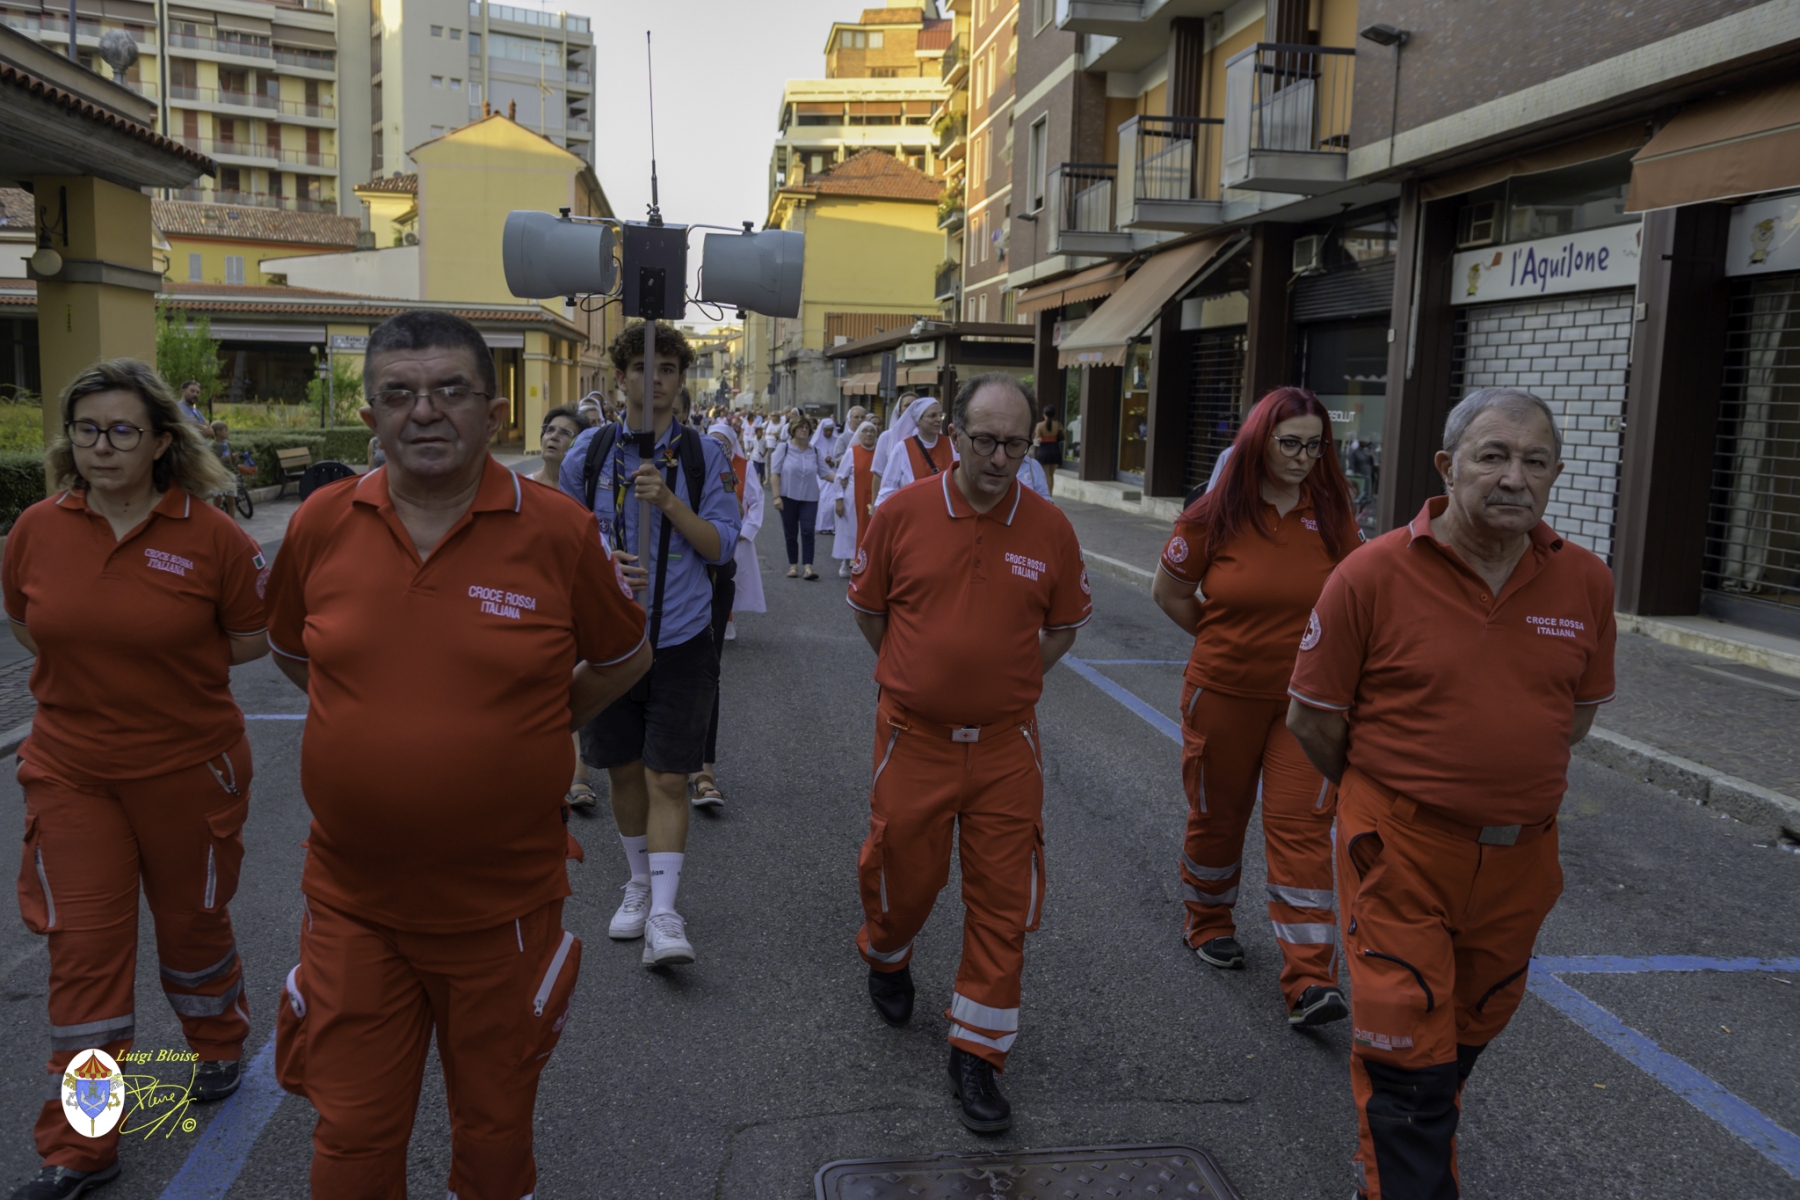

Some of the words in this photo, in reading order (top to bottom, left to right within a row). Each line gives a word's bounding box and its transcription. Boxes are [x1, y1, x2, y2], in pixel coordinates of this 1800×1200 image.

[1511, 242, 1610, 292] l'Aquilone
[1004, 552, 1027, 566] CROCE
[1027, 557, 1046, 574] ROSSA
[1011, 564, 1039, 582] ITALIANA
[468, 585, 504, 603] CROCE
[505, 592, 536, 611] ROSSA
[480, 600, 521, 619] ITALIANA
[1526, 615, 1557, 626] CROCE
[1559, 618, 1585, 631] ROSSA
[1537, 626, 1576, 638] ITALIANA
